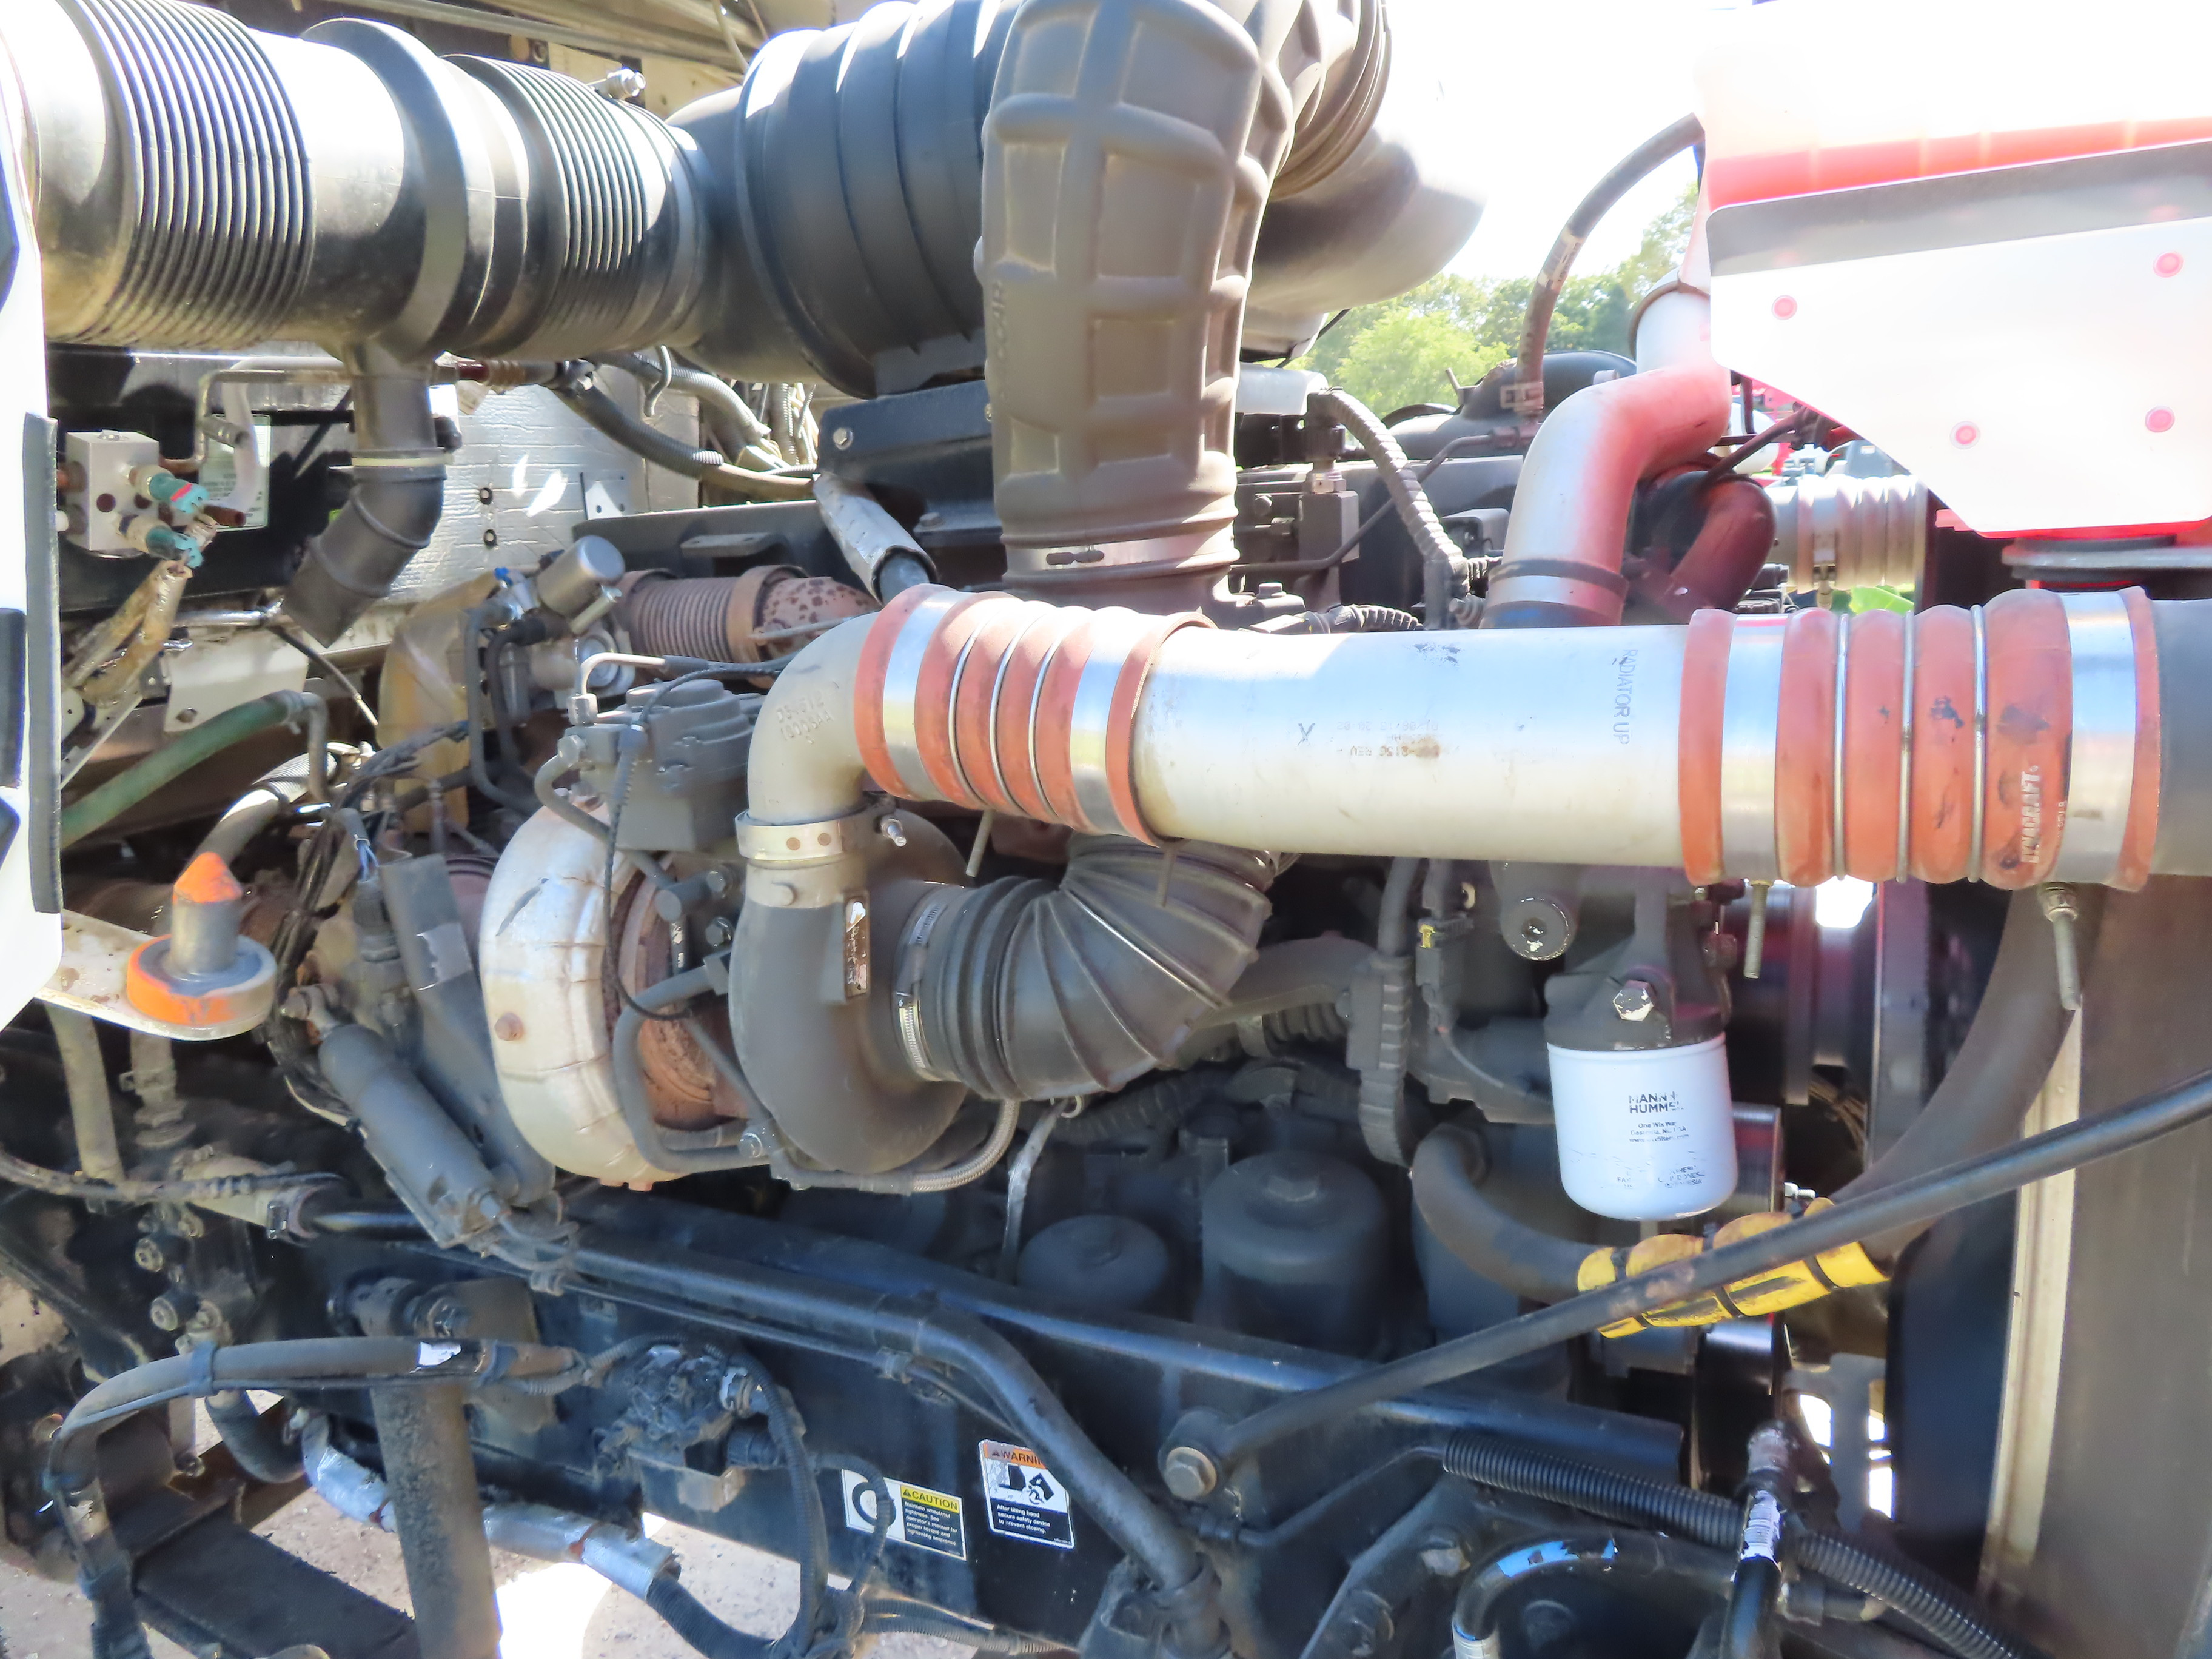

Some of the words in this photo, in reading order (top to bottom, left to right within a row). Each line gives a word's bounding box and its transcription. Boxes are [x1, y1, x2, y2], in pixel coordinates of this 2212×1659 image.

[1614, 650, 1638, 717] RADIATOR
[1613, 722, 1630, 745] UP
[912, 1491, 957, 1510] CAUTION
